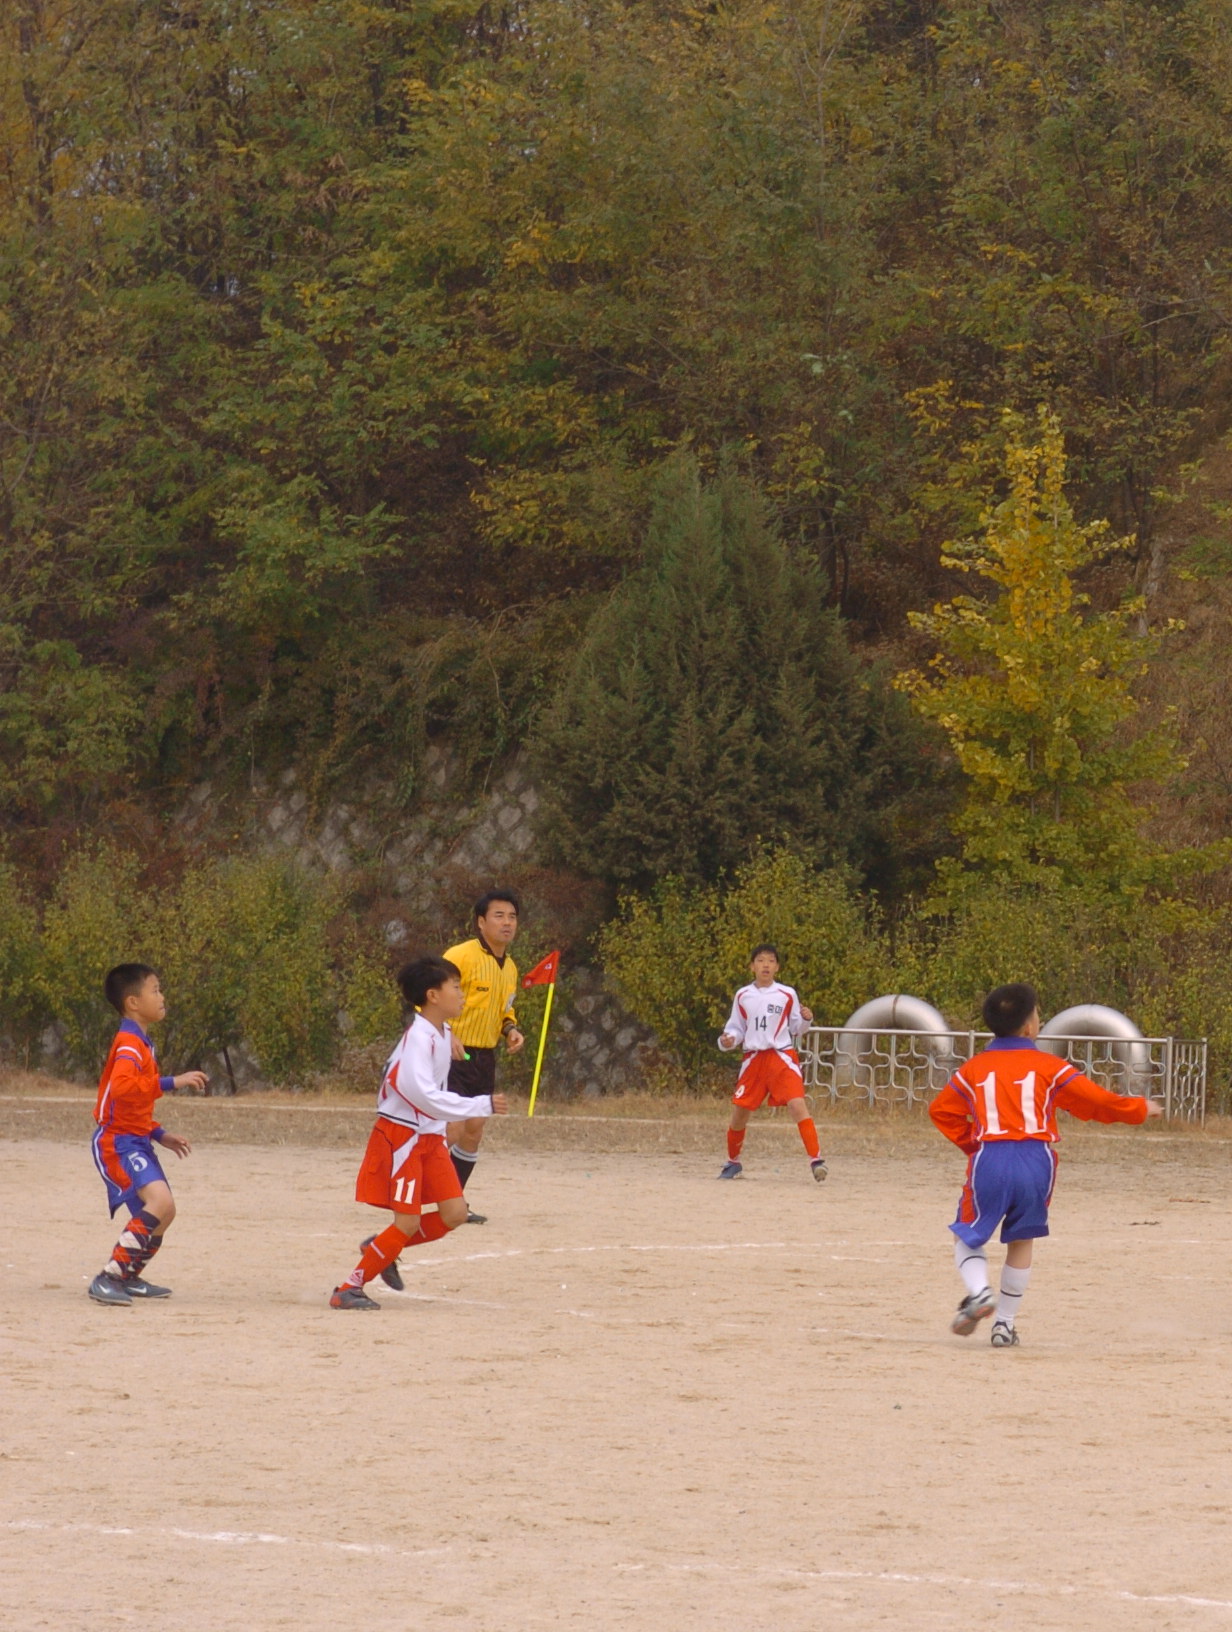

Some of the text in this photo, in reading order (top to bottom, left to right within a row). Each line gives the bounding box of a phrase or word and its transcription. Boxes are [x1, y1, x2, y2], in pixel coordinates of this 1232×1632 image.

[755, 1015, 767, 1031] 14
[976, 1071, 1046, 1135] 11
[128, 1151, 148, 1172] 5
[394, 1177, 416, 1204] 11
